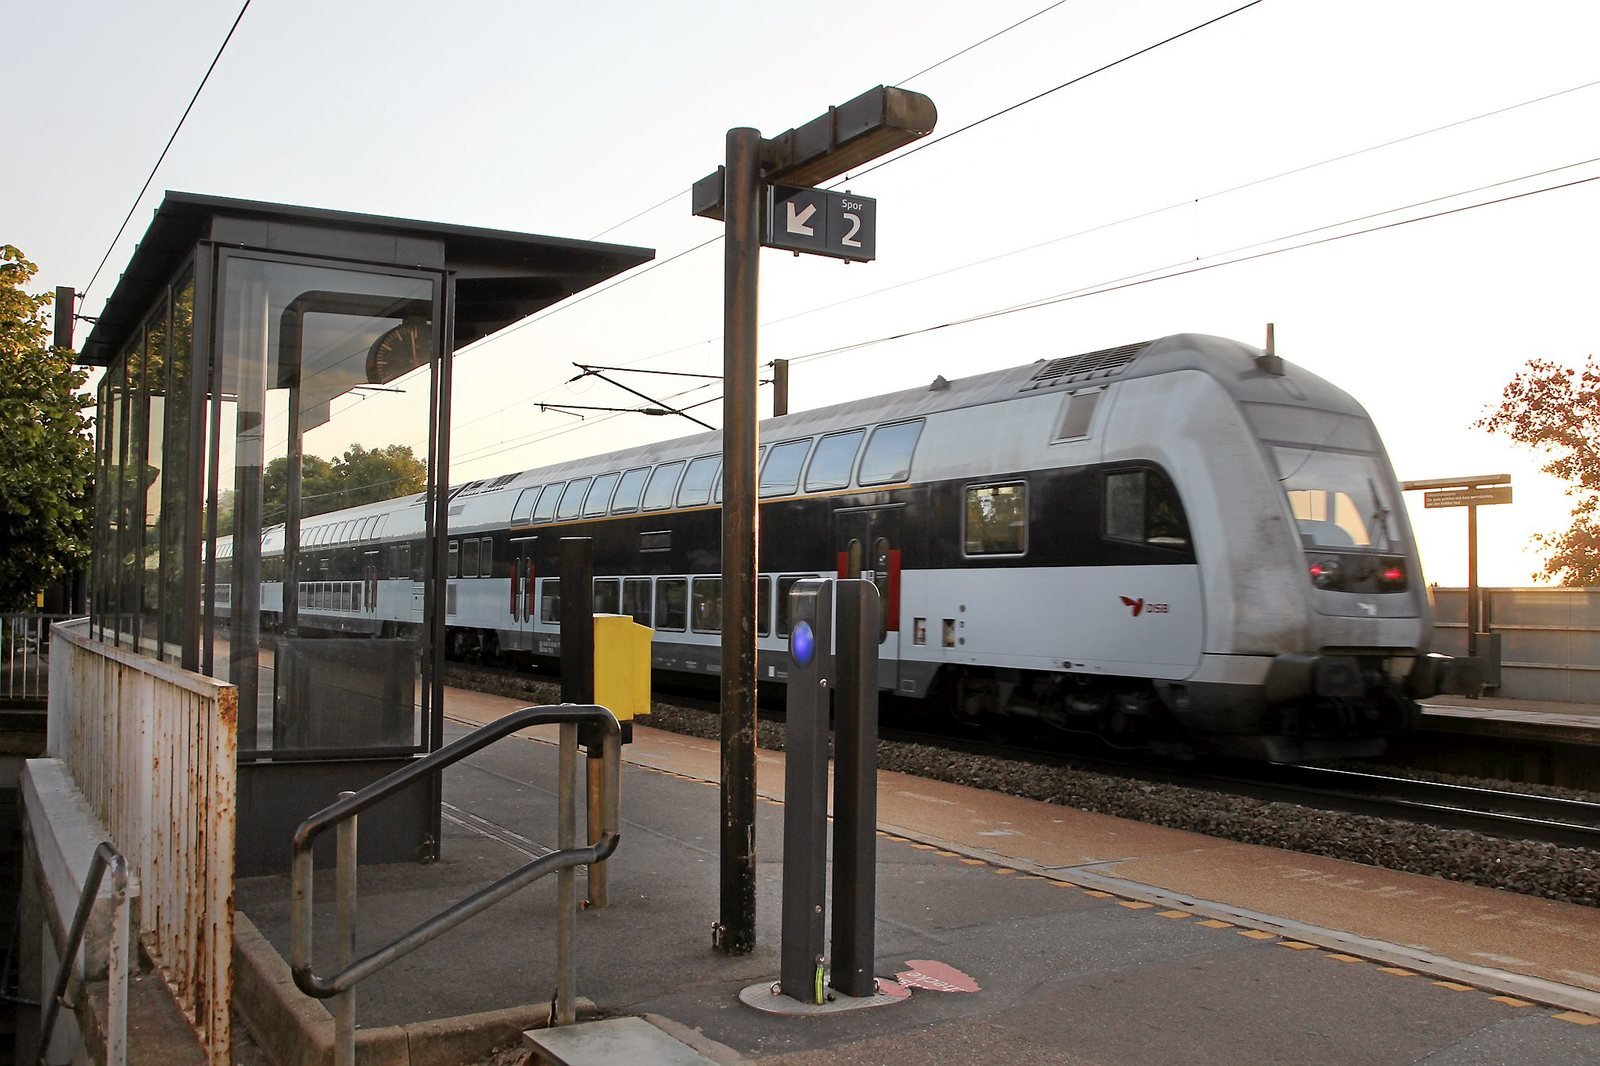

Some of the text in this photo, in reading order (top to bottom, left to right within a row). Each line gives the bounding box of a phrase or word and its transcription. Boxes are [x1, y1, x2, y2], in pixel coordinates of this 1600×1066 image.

[842, 199, 862, 210] Spor
[842, 212, 861, 247] 2
[1147, 603, 1168, 613] DSB
